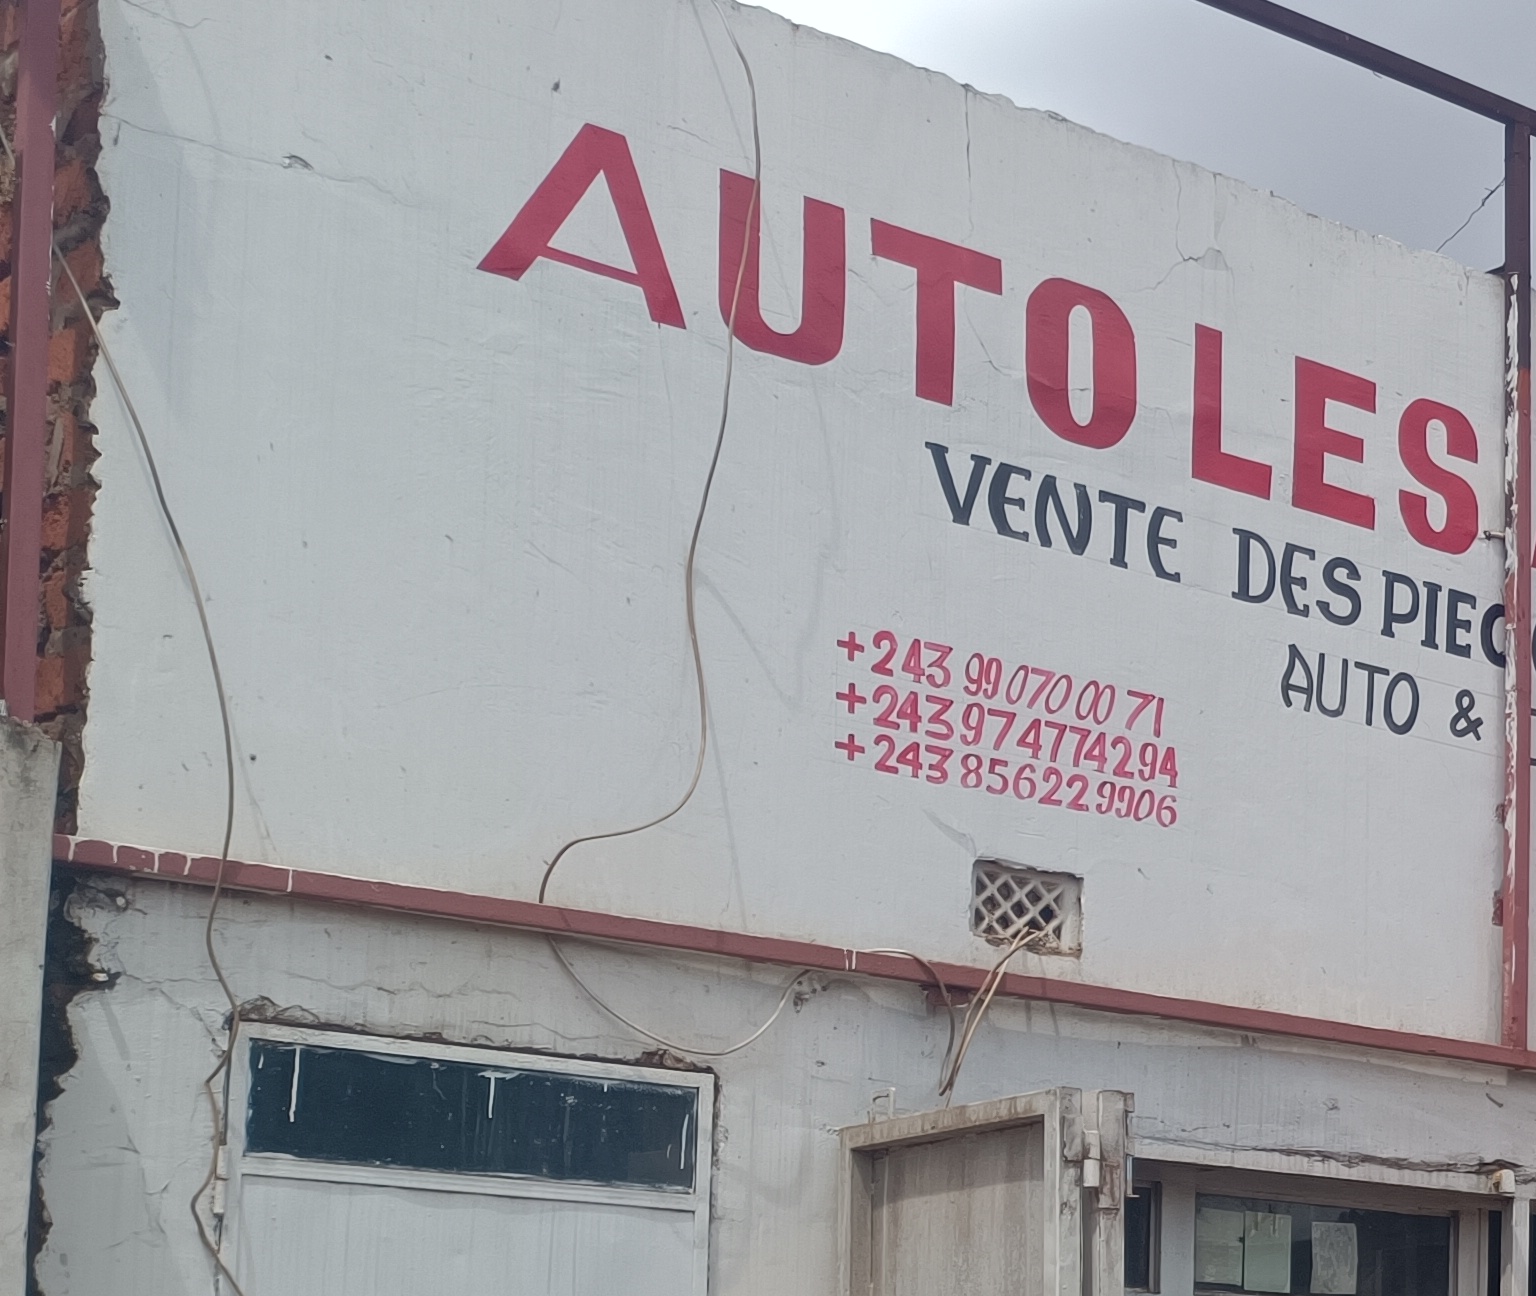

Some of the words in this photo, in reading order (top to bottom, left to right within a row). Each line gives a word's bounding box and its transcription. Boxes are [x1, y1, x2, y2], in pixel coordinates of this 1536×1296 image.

[476, 122, 1137, 450] AUTO
[1191, 323, 1479, 555] LES
[925, 441, 1183, 583] VENTE
[1233, 527, 1361, 627] DES
[1281, 643, 1420, 737] AUTO
[1449, 688, 1484, 742] &
